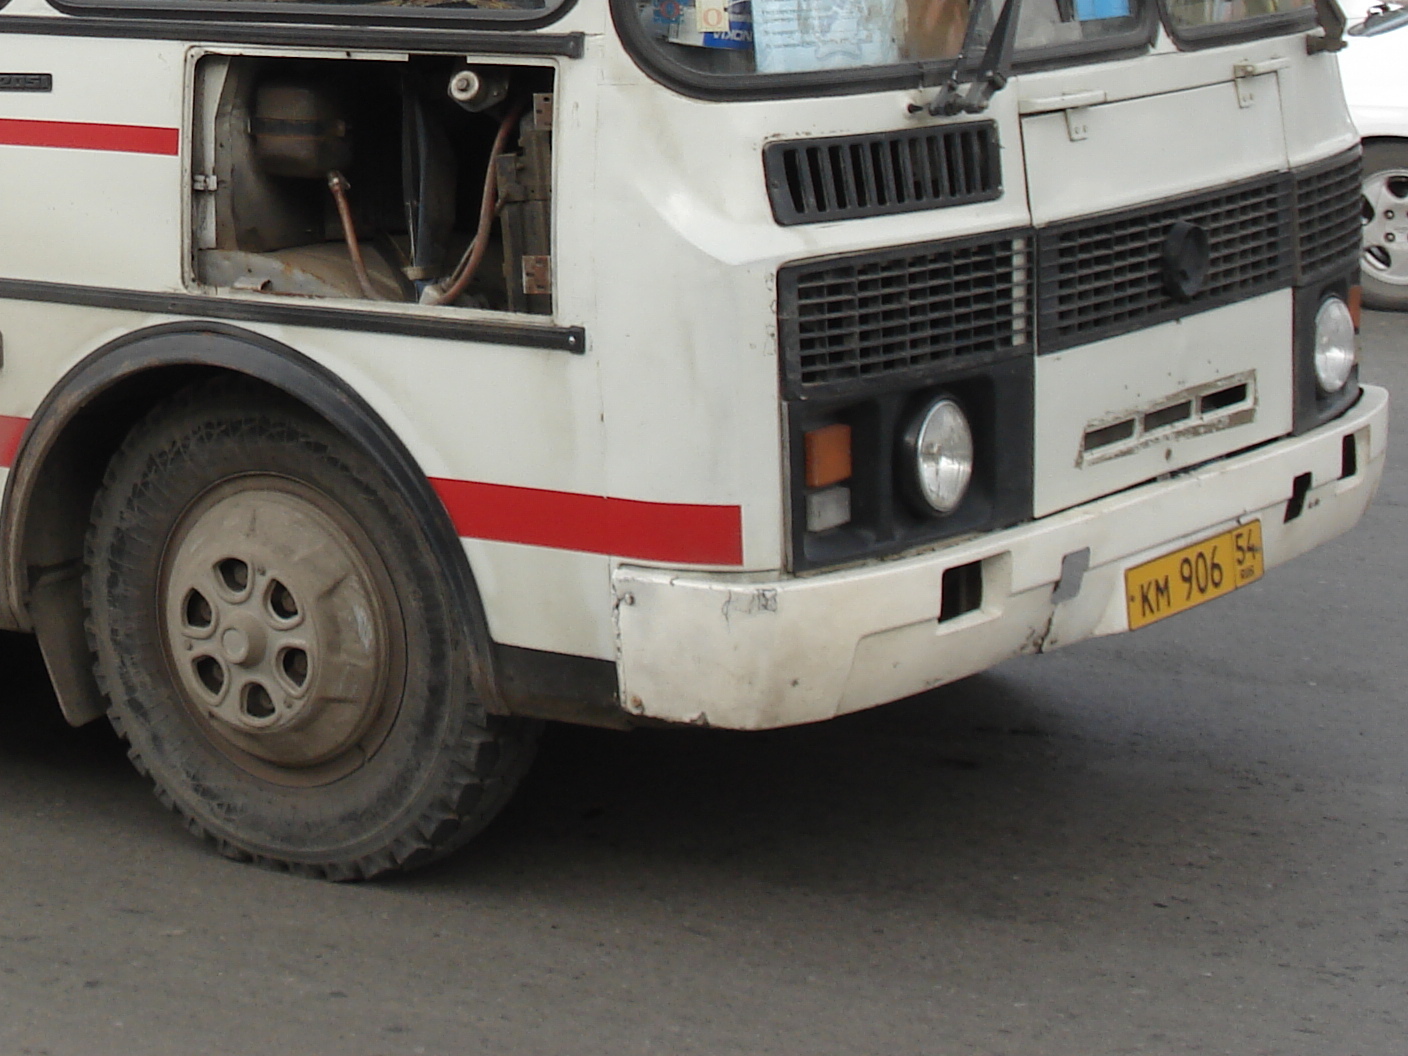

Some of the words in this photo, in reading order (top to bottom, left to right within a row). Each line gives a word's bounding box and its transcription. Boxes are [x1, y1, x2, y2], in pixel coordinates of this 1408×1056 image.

[1140, 574, 1171, 618] КМ
[1179, 544, 1224, 602] 906
[1235, 527, 1257, 566] 54
